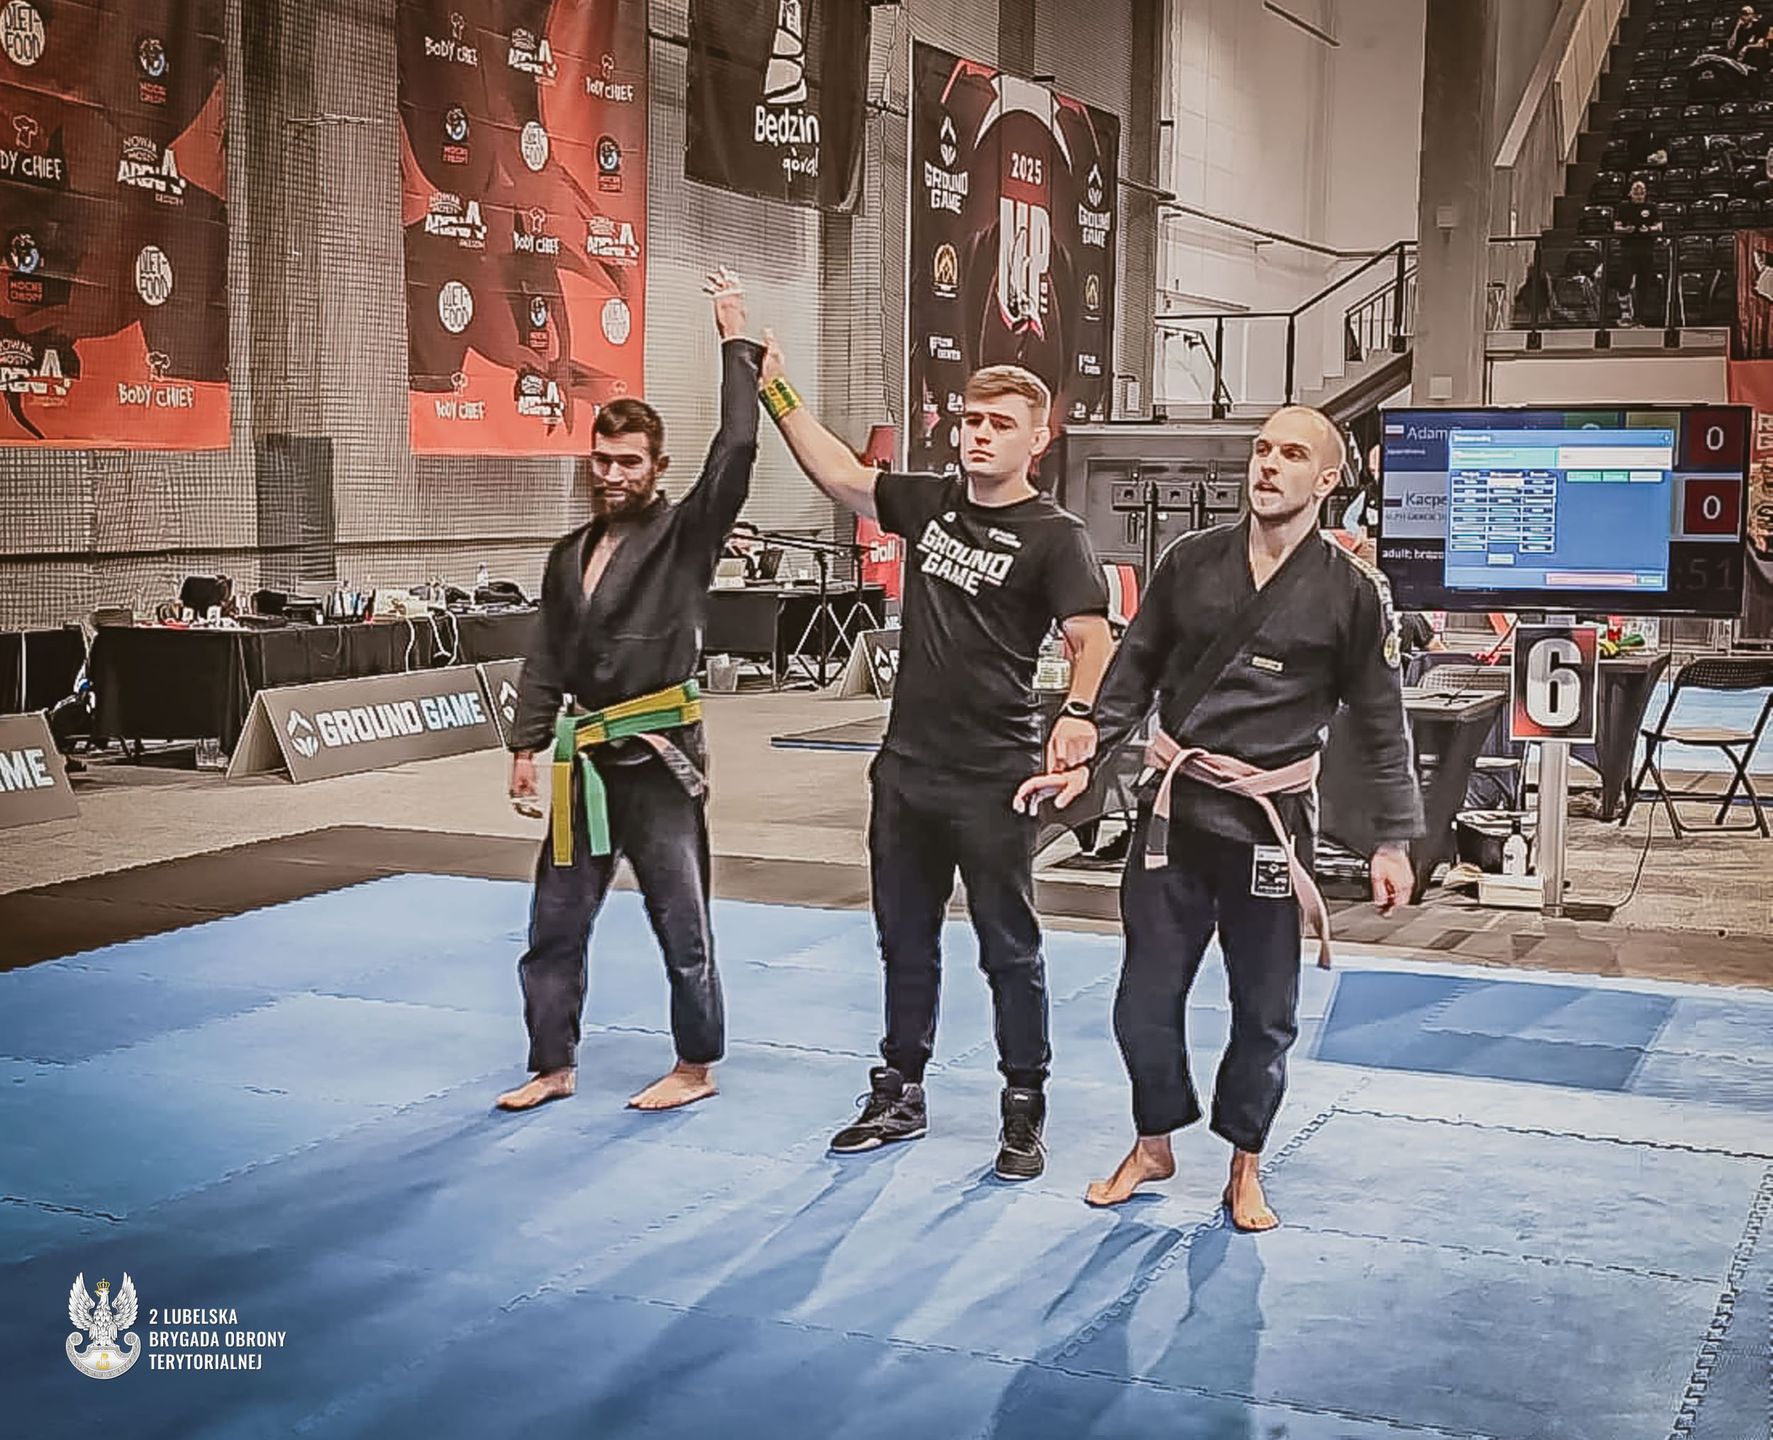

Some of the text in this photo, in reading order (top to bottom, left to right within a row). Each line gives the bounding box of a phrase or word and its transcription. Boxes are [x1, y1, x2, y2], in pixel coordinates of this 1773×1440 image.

[754, 105, 820, 146] Będzin
[22, 155, 62, 180] CHIEF
[924, 160, 968, 196] GROUND
[1009, 152, 1043, 185] 2025
[931, 189, 962, 214] GAME
[118, 383, 194, 408] BODY CHIEF
[1407, 426, 1448, 441] Adam
[1706, 426, 1724, 450] 0
[1703, 495, 1721, 519] 0
[921, 519, 1014, 581] GROUND
[921, 551, 984, 596] GAME
[1526, 638, 1582, 728] 6
[315, 692, 487, 747] GROUND GAME
